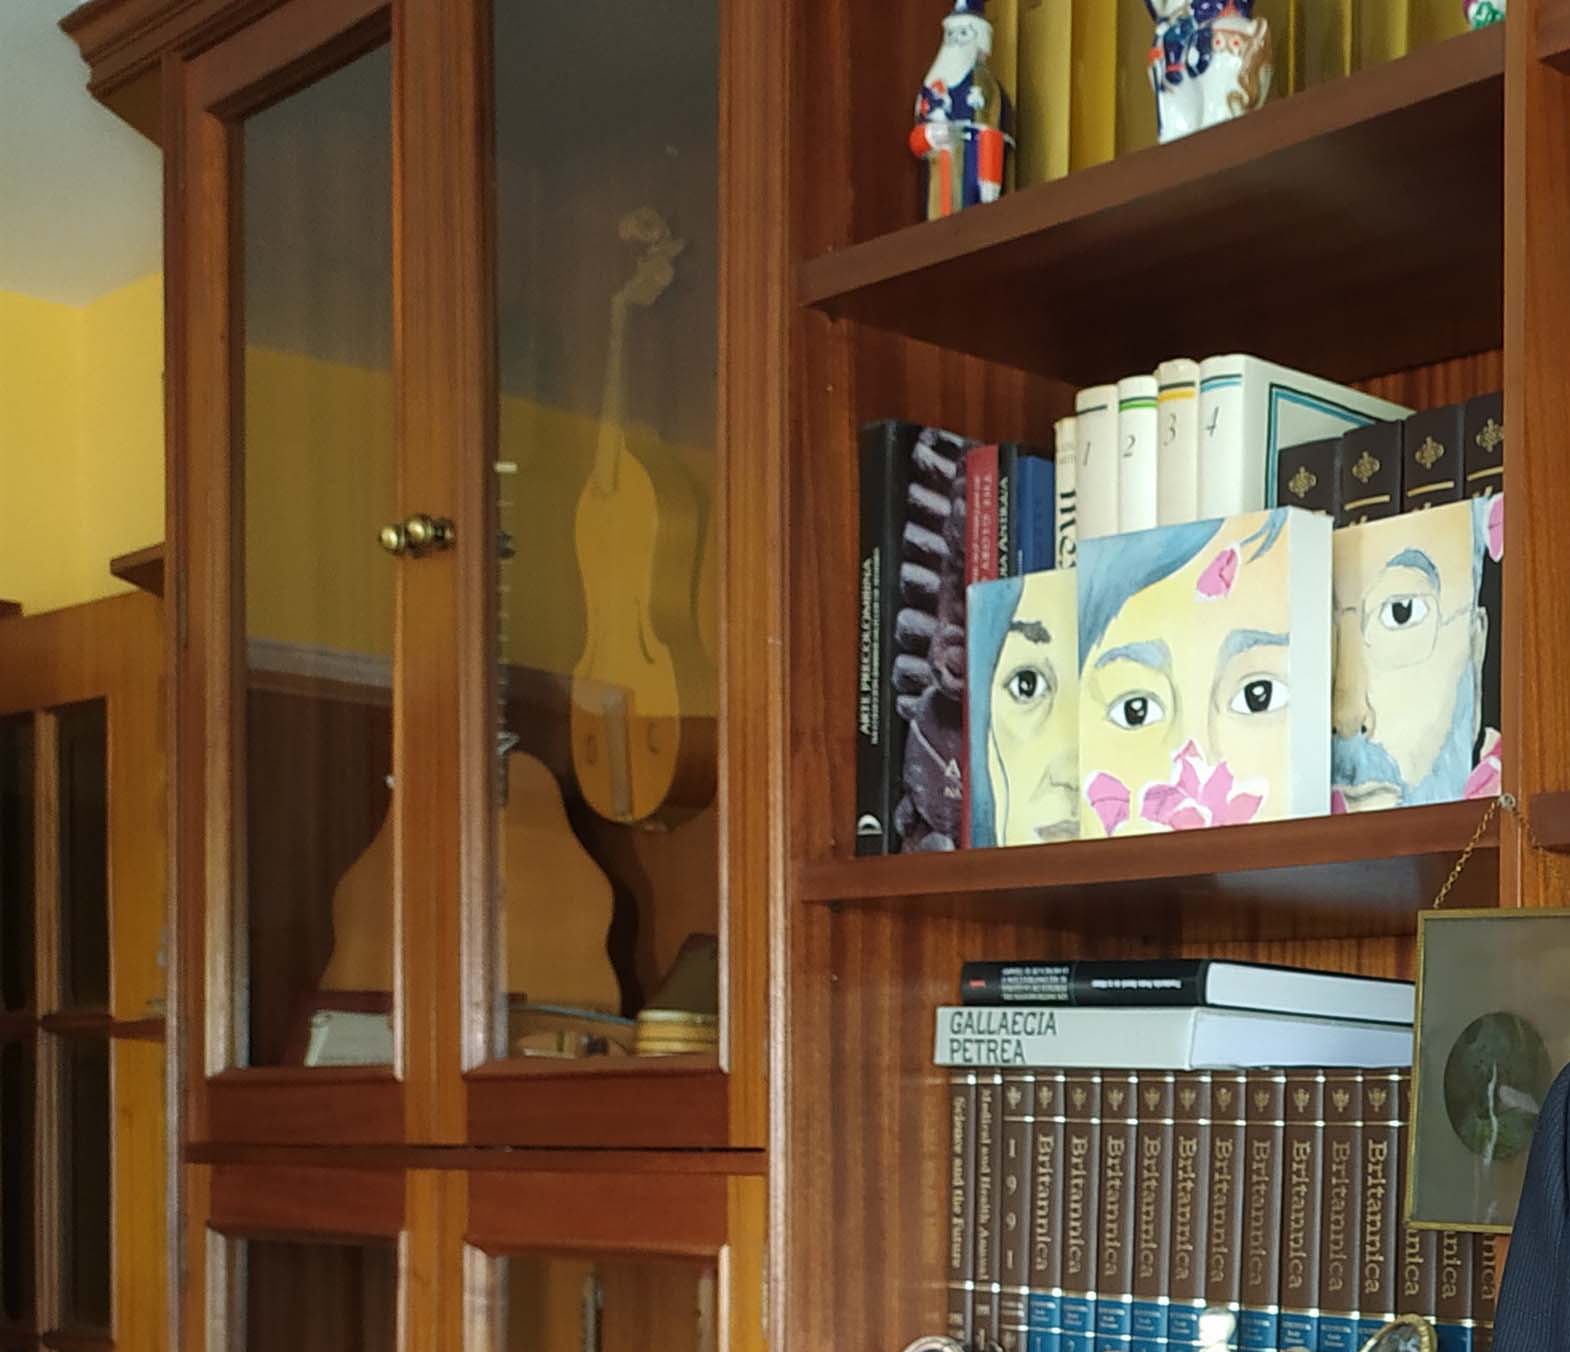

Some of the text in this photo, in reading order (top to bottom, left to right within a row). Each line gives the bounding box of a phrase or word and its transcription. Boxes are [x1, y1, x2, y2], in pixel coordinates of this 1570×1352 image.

[1083, 441, 1092, 467] 1
[1122, 435, 1136, 458] 2
[1163, 413, 1177, 446] 3
[1205, 405, 1220, 438] 4
[949, 1038, 1026, 1063] PETREA
[950, 1011, 1057, 1036] GALLAECIA
[1036, 1134, 1054, 1272] Britannica
[1069, 1135, 1088, 1275] Britannica
[1104, 1136, 1125, 1277] Britannica
[1140, 1136, 1161, 1279] Britannica
[1176, 1136, 1198, 1280] Britannica
[1210, 1138, 1234, 1283] Britannica
[1249, 1139, 1271, 1287] Britannica
[1288, 1140, 1312, 1290] Britannica
[1327, 1140, 1351, 1292] Britannica
[1364, 1139, 1388, 1294] Britannica
